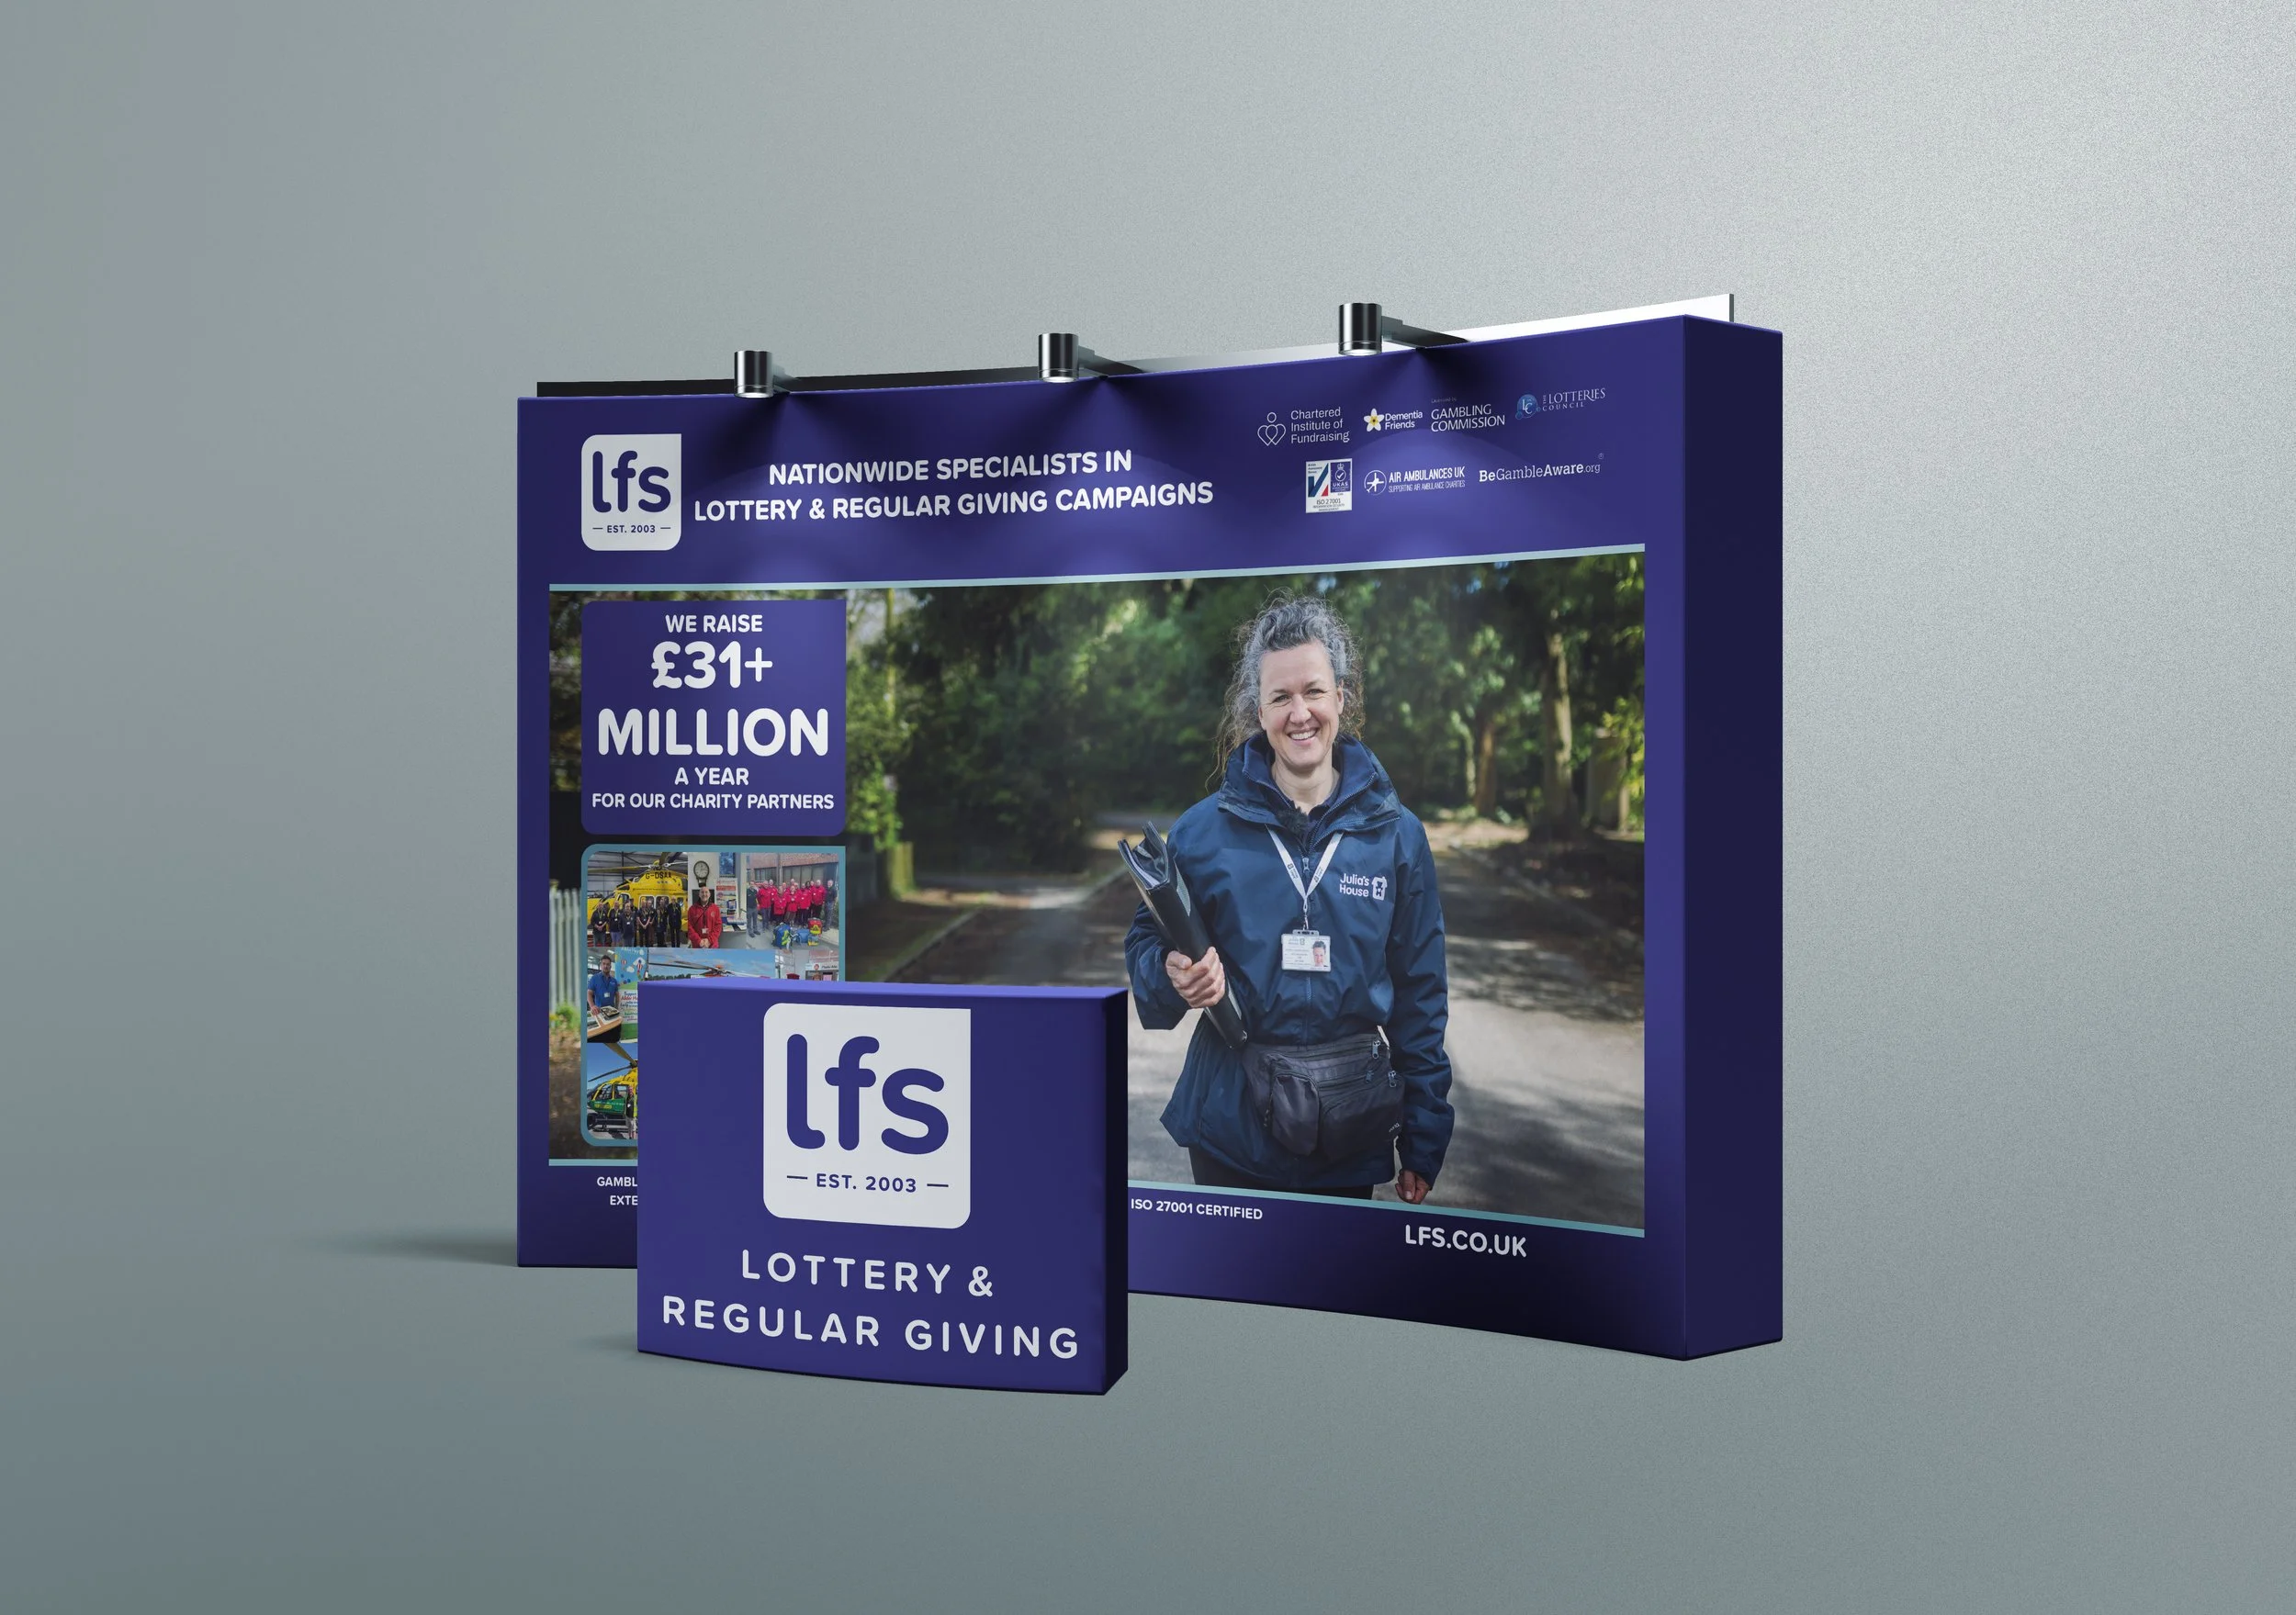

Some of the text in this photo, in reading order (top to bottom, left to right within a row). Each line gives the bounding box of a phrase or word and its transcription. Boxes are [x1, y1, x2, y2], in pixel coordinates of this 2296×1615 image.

[1548, 387, 1606, 404] LOTTERIES
[1290, 406, 1341, 420] Chartered
[1431, 404, 1491, 420] GAMBLING
[1542, 401, 1585, 411] COUNCIL
[1385, 410, 1424, 421] Dementia
[1431, 415, 1505, 432] COMMISSION
[1290, 419, 1343, 432] Institute of
[1385, 420, 1415, 430] Friends
[1290, 431, 1350, 443] Fundraising
[769, 449, 1131, 485] NATIONWIDE SPECIALISTS IN
[1389, 465, 1465, 483] AIR AMBULANCES UK
[1479, 463, 1601, 482] BeGambleAware.org
[592, 450, 671, 513] lfs
[1388, 484, 1413, 493] SUPPORTING
[1421, 482, 1445, 490] AMBULANCE
[1445, 480, 1465, 488] CHARITIES
[694, 481, 1213, 522] LOTTERY & REGULAR GIVING CAMPAIGNS
[607, 524, 656, 533] EST. 2003
[665, 614, 763, 633] WE RAISE
[651, 641, 773, 689] £31+
[598, 708, 828, 757] MILLION
[674, 767, 749, 785] A YEAR
[592, 792, 834, 810] FOR OUR CHARITY PARTNERS
[1339, 873, 1369, 887] Julia's
[1339, 884, 1369, 897] House
[786, 1033, 949, 1155] lfs
[816, 1172, 917, 1194] EST. 2003
[1131, 1198, 1263, 1220] ISO 27001 CERTIFIED
[1405, 1224, 1527, 1258] LFS.CO.UK
[741, 1250, 994, 1297] LOTTERY &
[663, 1295, 1079, 1359] REGULAR GIVING
